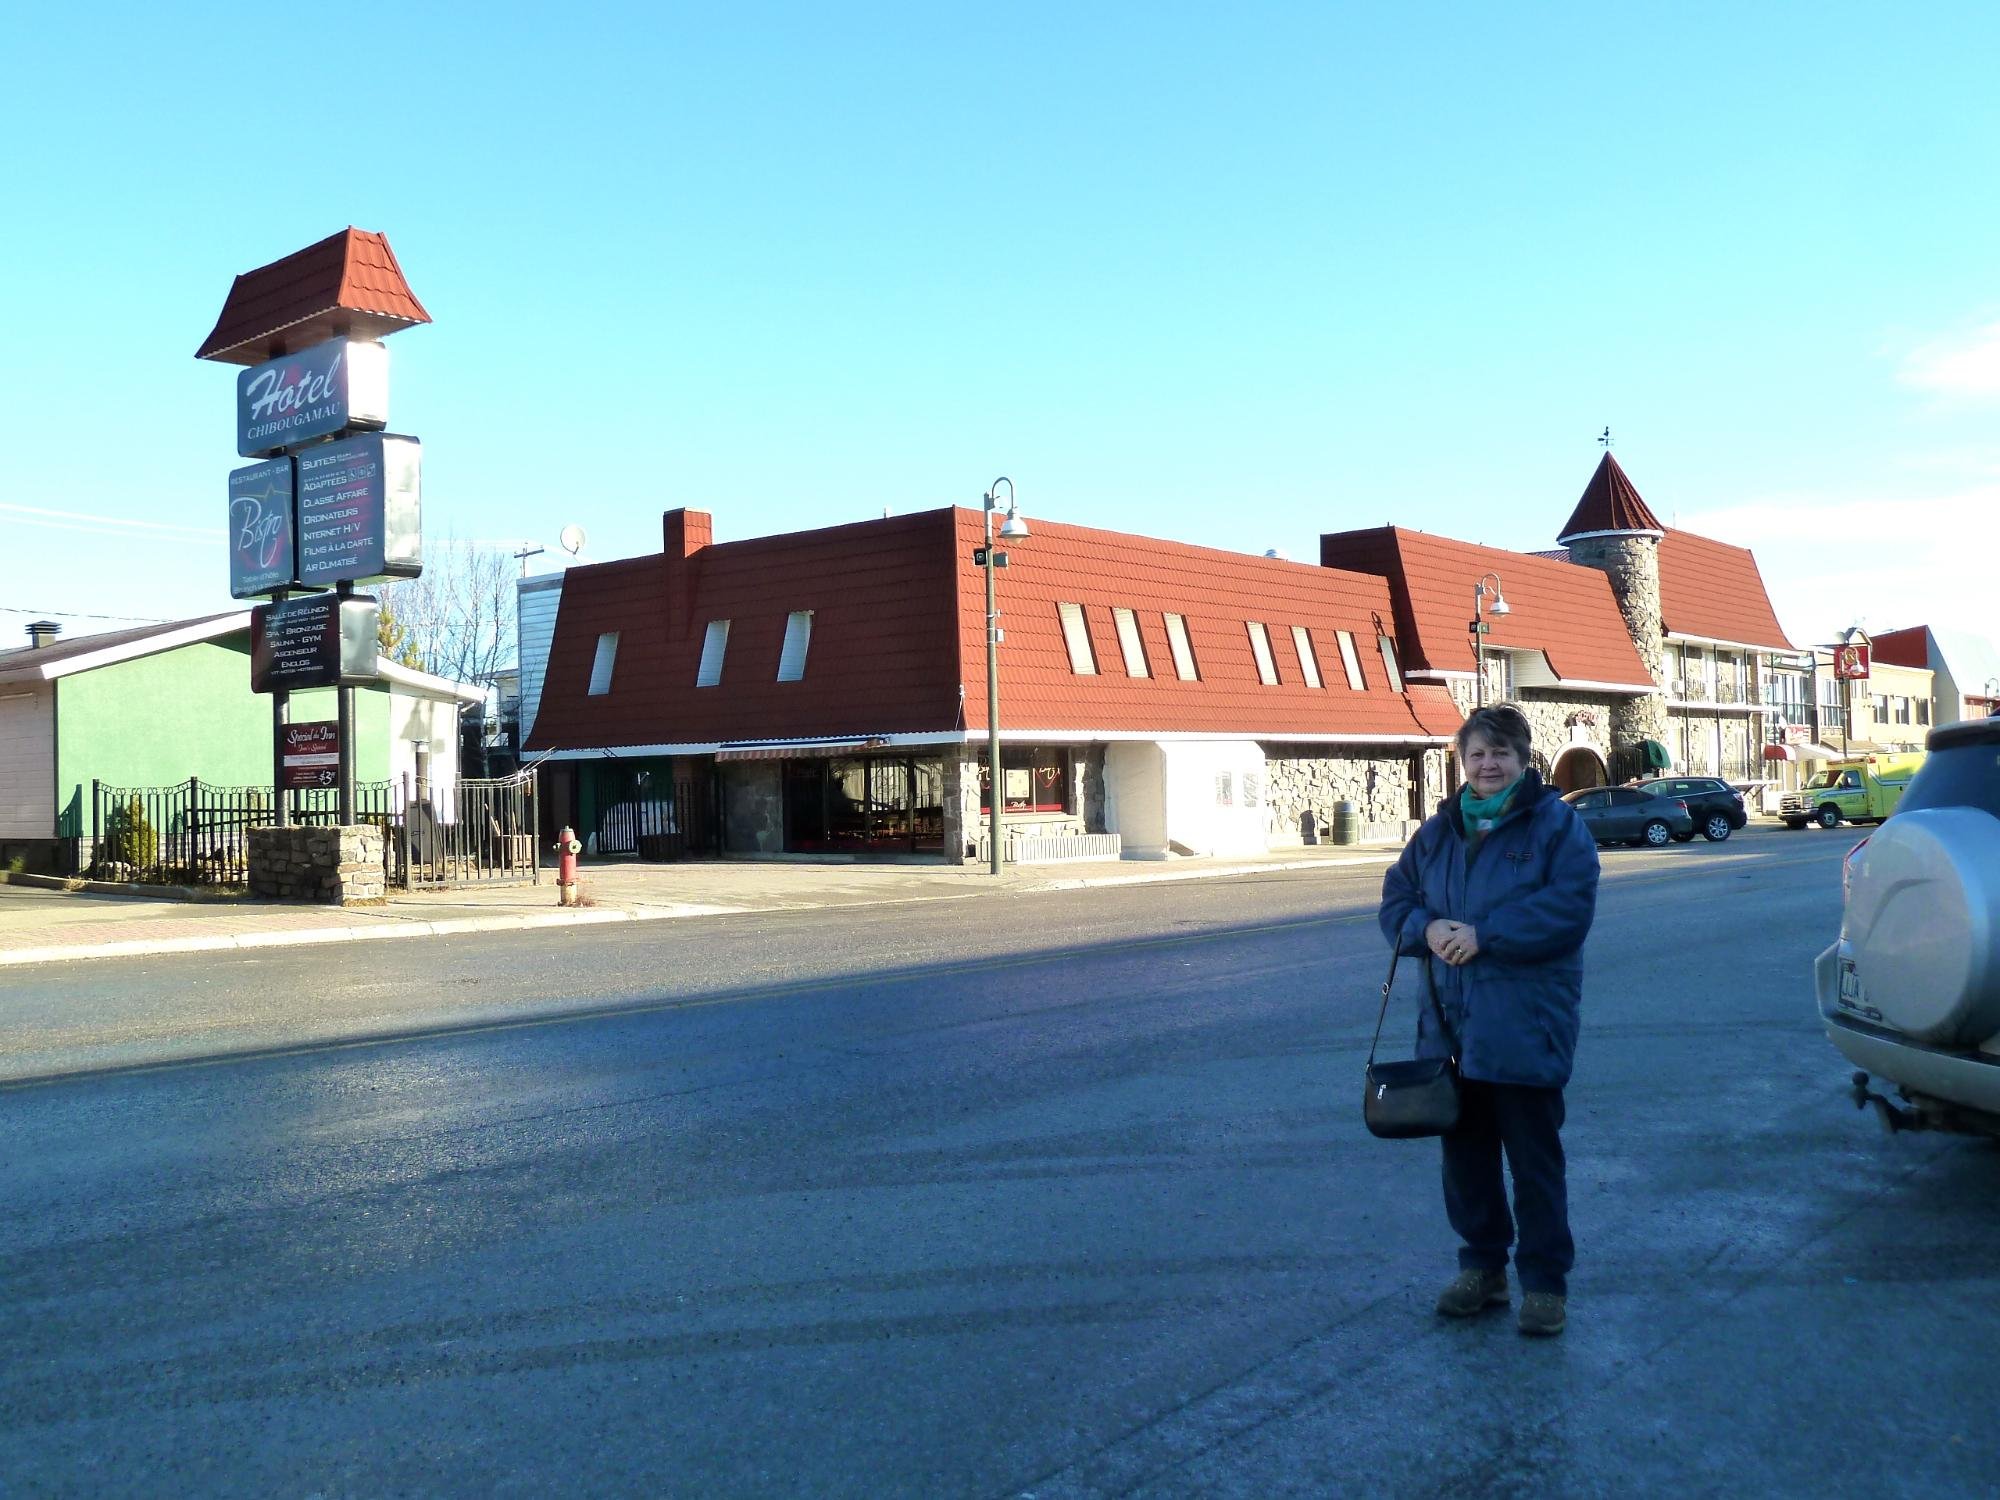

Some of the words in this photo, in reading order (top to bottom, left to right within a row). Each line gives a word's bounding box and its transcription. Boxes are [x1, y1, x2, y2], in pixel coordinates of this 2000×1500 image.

[246, 354, 340, 420] Hotel
[247, 402, 340, 440] CHIBOUGAMAU
[302, 456, 336, 470] SUITES
[303, 496, 334, 508] CLASSE
[336, 488, 368, 502] AFFAIRE
[303, 508, 358, 524] ORDINATEURS
[303, 528, 340, 540] INTERNET
[304, 546, 326, 556] FILMS
[335, 542, 346, 550] LA
[346, 538, 374, 548] CARTE
[305, 564, 318, 572] AIR
[319, 554, 358, 570] CLIMATISÉ
[265, 612, 286, 620] SALLE
[297, 606, 328, 616] RÉUNION
[285, 624, 328, 634] BRONZAGE
[270, 640, 294, 648] SAUNA
[302, 634, 322, 642] GYM
[274, 648, 318, 658] ASCENSEUR
[281, 660, 310, 668] ENCLOS
[320, 726, 336, 740] Inn
